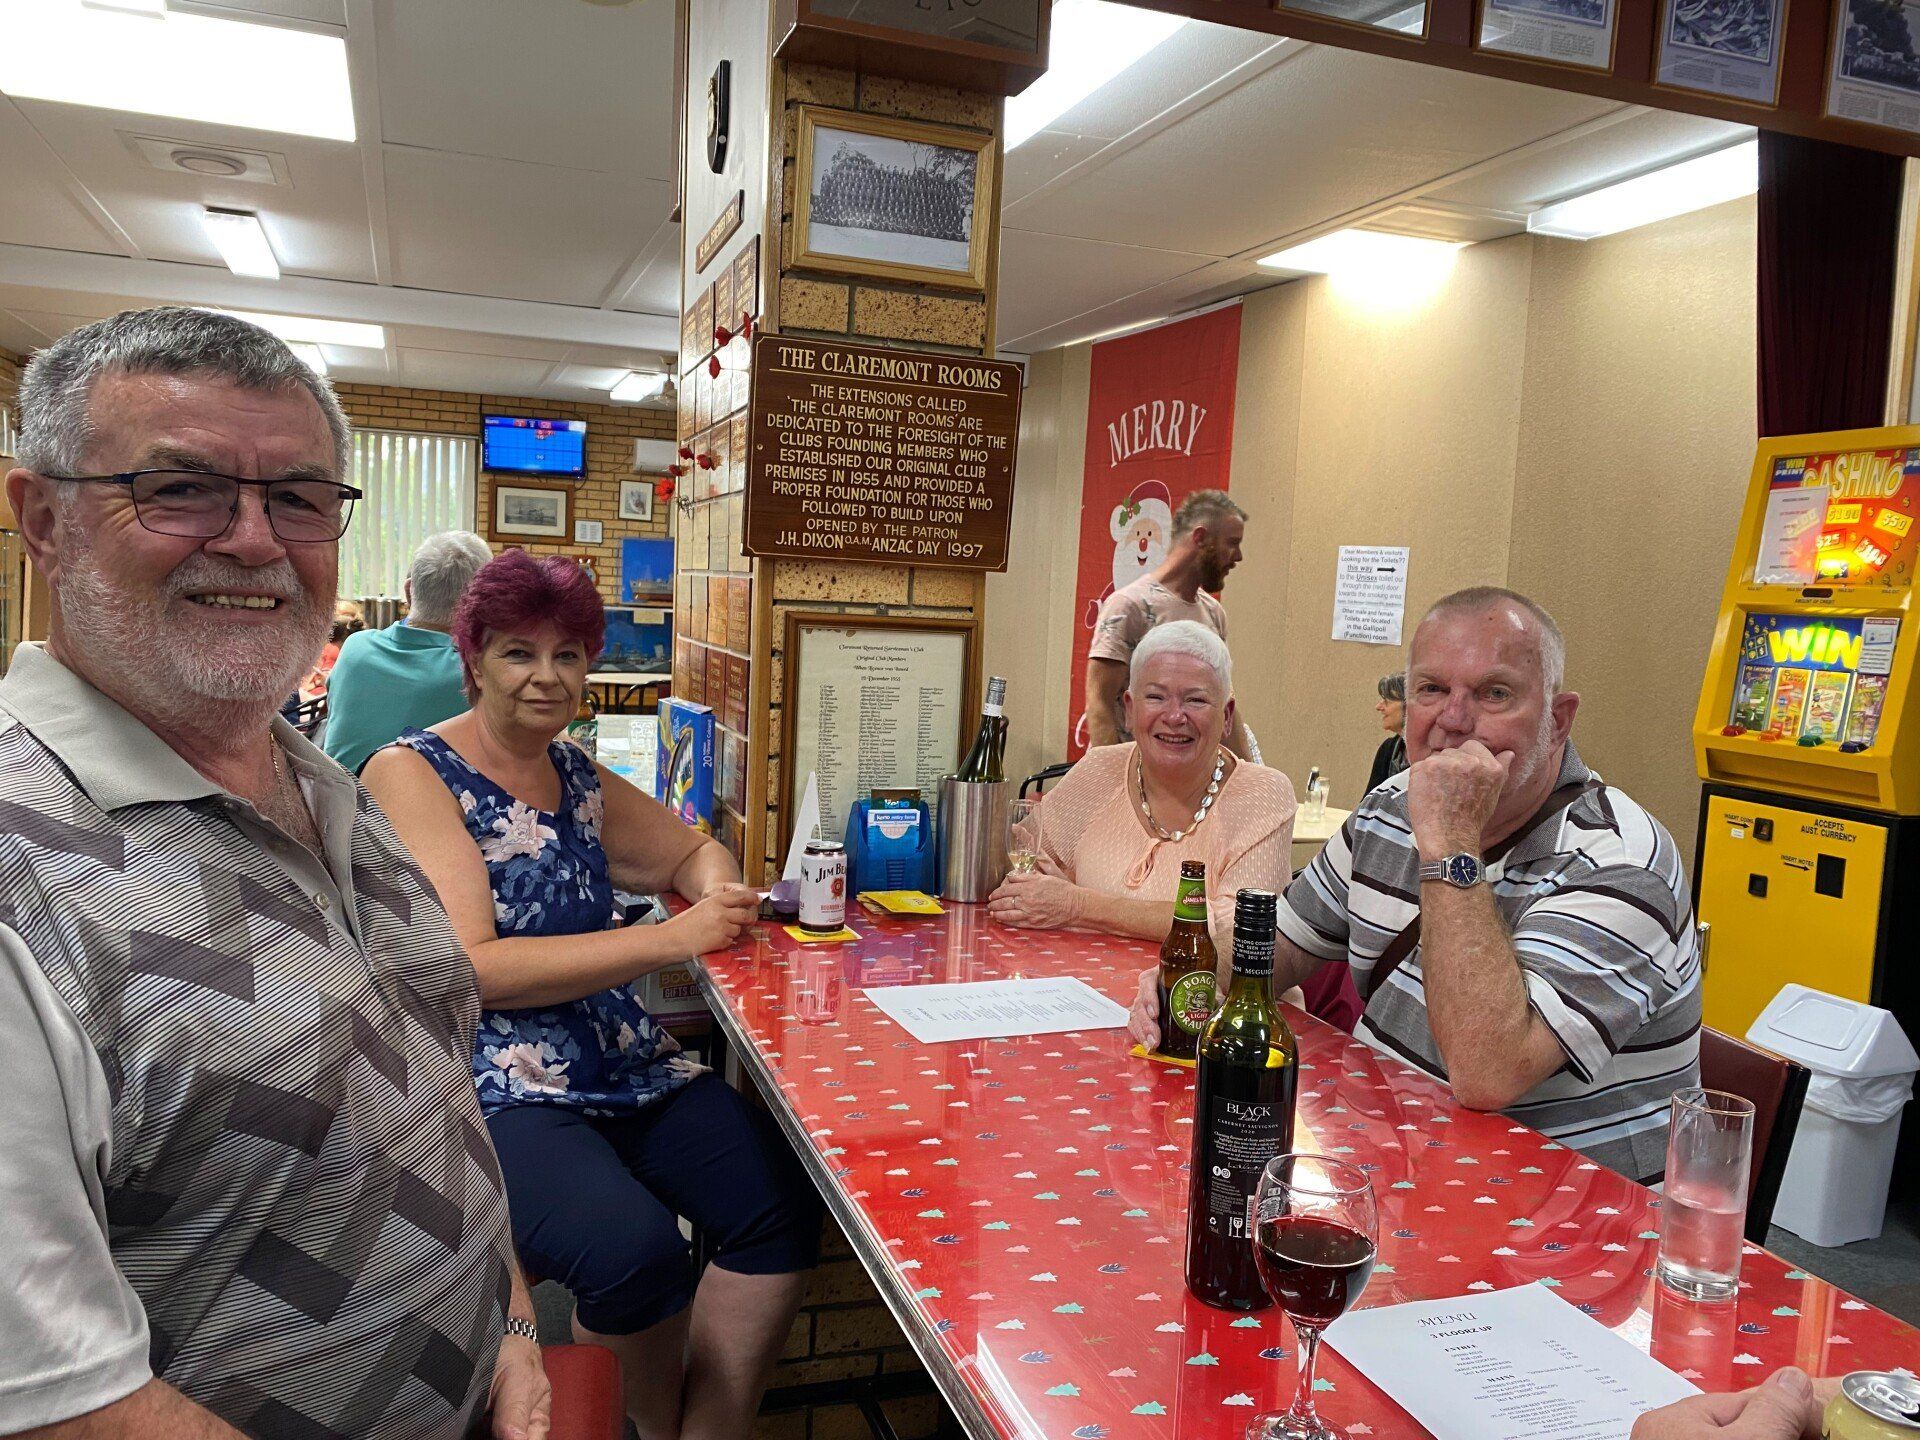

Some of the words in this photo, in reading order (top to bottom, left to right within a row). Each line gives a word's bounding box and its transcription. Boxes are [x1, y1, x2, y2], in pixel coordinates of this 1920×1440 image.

[779, 347, 815, 368] THE
[822, 352, 932, 381] CLAREMONT
[938, 365, 1001, 389] ROOMS
[811, 384, 834, 398] THE
[839, 388, 912, 406] EXTENSIONS
[917, 396, 966, 412] CALLED
[822, 403, 902, 422] CLAREMONT
[959, 417, 982, 430] ARE
[768, 414, 840, 433] DEDICATED
[846, 421, 863, 434] TO
[868, 424, 892, 438] THE
[898, 427, 964, 445] FORESIGHT
[968, 434, 983, 446] OF
[987, 436, 1006, 448] THE
[1107, 400, 1206, 468] MERRY
[780, 433, 822, 447] CLUBS
[828, 437, 891, 455] FOUNDING
[897, 443, 954, 459] MEMBERS
[960, 449, 987, 462] WHO
[780, 449, 861, 468] ESTABLISHED
[866, 457, 891, 470] OUR
[897, 460, 950, 475] ORIGINAL
[955, 465, 986, 478] CLUB
[1786, 459, 1806, 468] WIN
[766, 465, 826, 481] PREMISES
[833, 470, 844, 482] IN
[851, 472, 879, 485] 1955
[884, 475, 910, 488] AND
[915, 478, 972, 493] PROVIDED
[977, 482, 984, 494] A
[773, 481, 820, 498] PROPER
[826, 486, 901, 503] FOUNDATION
[906, 492, 927, 506] FOR
[931, 495, 965, 508] THOSE
[969, 498, 992, 510] WHO
[802, 501, 865, 517] FOLLOWED
[871, 506, 886, 518] TO
[891, 508, 923, 521] BUILD
[930, 511, 963, 523] UPON
[807, 519, 857, 532] OPENED
[862, 522, 878, 534] BY
[884, 524, 907, 536] THE
[912, 527, 958, 539] PATRON
[776, 531, 800, 546] J.H.
[803, 533, 843, 549] DIXON
[871, 537, 913, 554] ANZAC
[918, 541, 940, 555] DAY
[947, 543, 983, 557] 1997
[1363, 624, 1386, 632] Gallipoli
[1769, 626, 1863, 670] WIN
[702, 756, 712, 768] 20
[1801, 825, 1818, 835] AUST.
[1821, 830, 1857, 843] CURRENCY
[1815, 819, 1844, 831] ACCEPTS
[1781, 855, 1797, 863] INSERT
[1799, 858, 1814, 866] NOTES
[816, 867, 833, 883] JIM
[662, 972, 691, 984] BOO
[1227, 1103, 1270, 1119] BLACK
[1218, 1119, 1245, 1127] CABERNET
[1418, 1312, 1478, 1327] MENU
